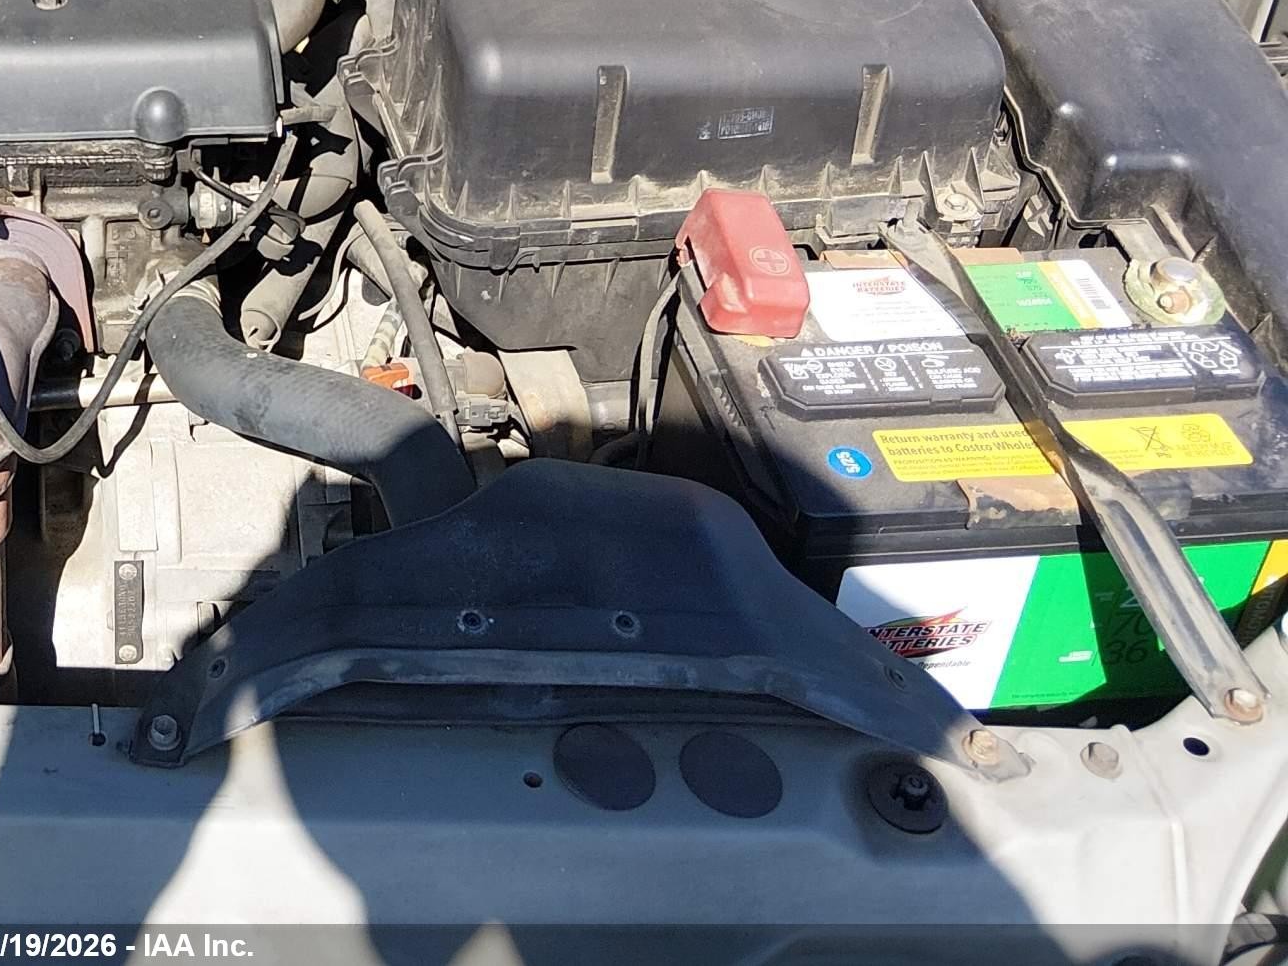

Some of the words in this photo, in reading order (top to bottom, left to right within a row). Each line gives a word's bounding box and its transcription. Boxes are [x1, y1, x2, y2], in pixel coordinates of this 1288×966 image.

[814, 345, 875, 356] DANGER
[887, 342, 944, 353] POISON
[880, 434, 921, 445] Return
[923, 431, 975, 443] warranty
[978, 429, 999, 440] and
[888, 445, 938, 456] batteries
[940, 444, 953, 454] to
[955, 442, 993, 453] Costco
[869, 622, 989, 639] NTERSTATE
[882, 635, 975, 651] TTERIES
